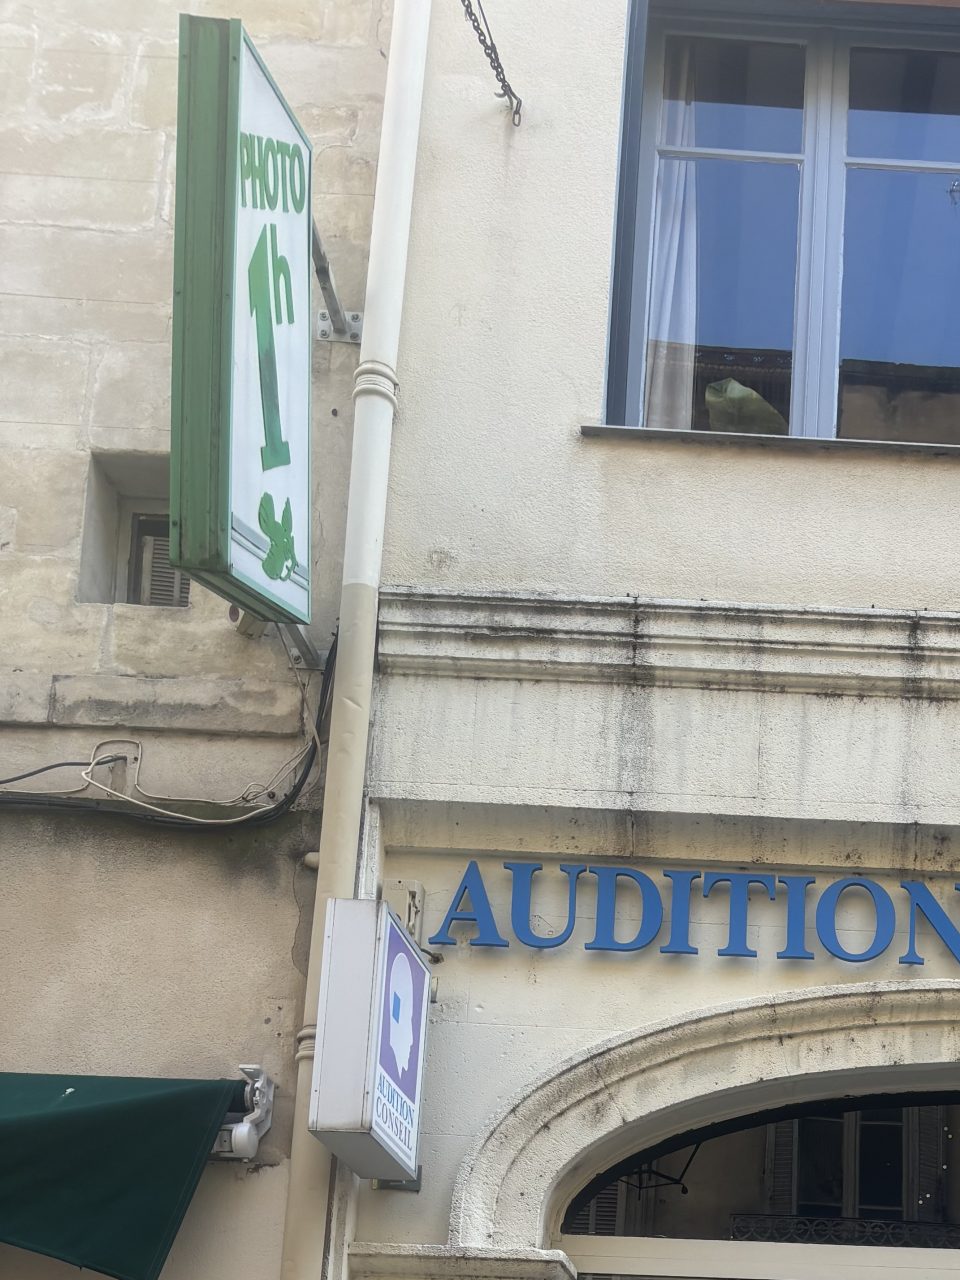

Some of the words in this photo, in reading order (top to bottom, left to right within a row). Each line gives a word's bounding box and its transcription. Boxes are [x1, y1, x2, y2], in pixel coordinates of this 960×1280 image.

[240, 132, 305, 214] PHOTO
[376, 1096, 412, 1151] CONSEIL
[377, 1072, 415, 1128] AUDITION
